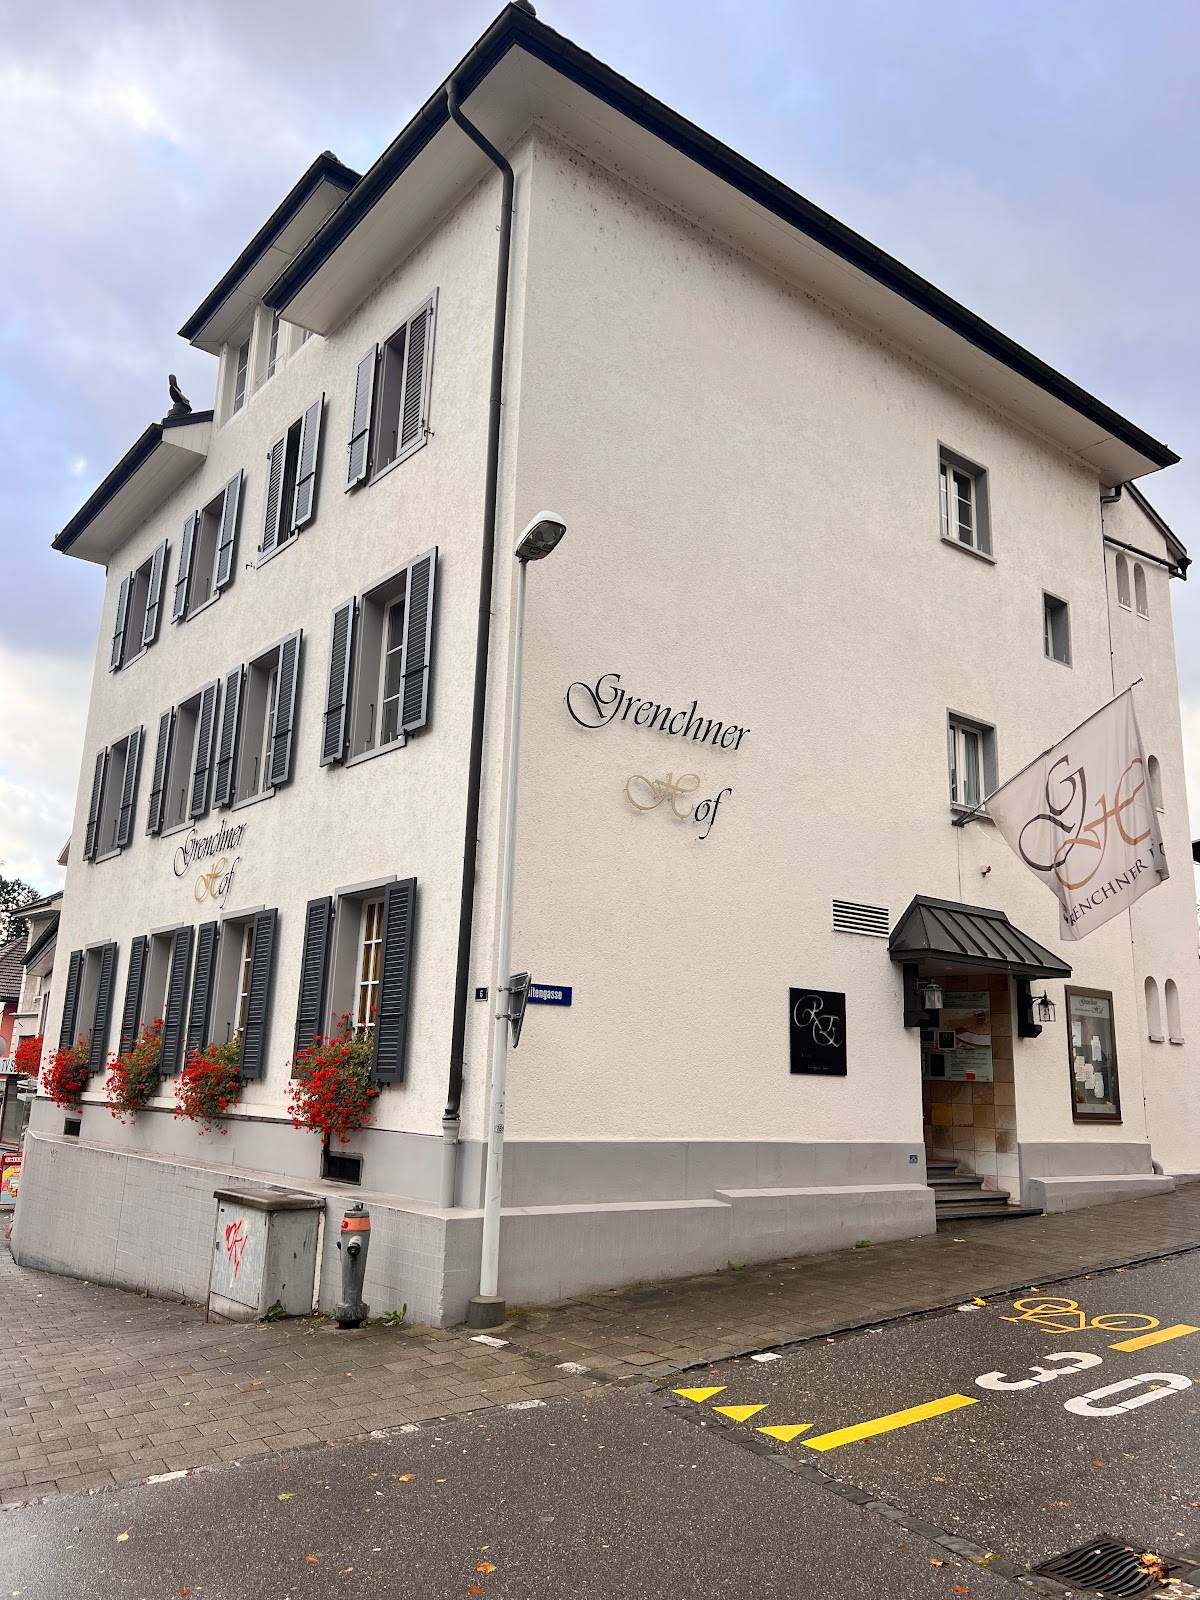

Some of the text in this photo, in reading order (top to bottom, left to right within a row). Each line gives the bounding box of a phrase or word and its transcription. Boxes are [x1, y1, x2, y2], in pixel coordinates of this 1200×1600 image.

[566, 673, 750, 751] Grenchner
[624, 772, 733, 840] Hof
[173, 817, 248, 877] Grenchner
[194, 856, 240, 909] Hof
[975, 1351, 1193, 1417] 30
